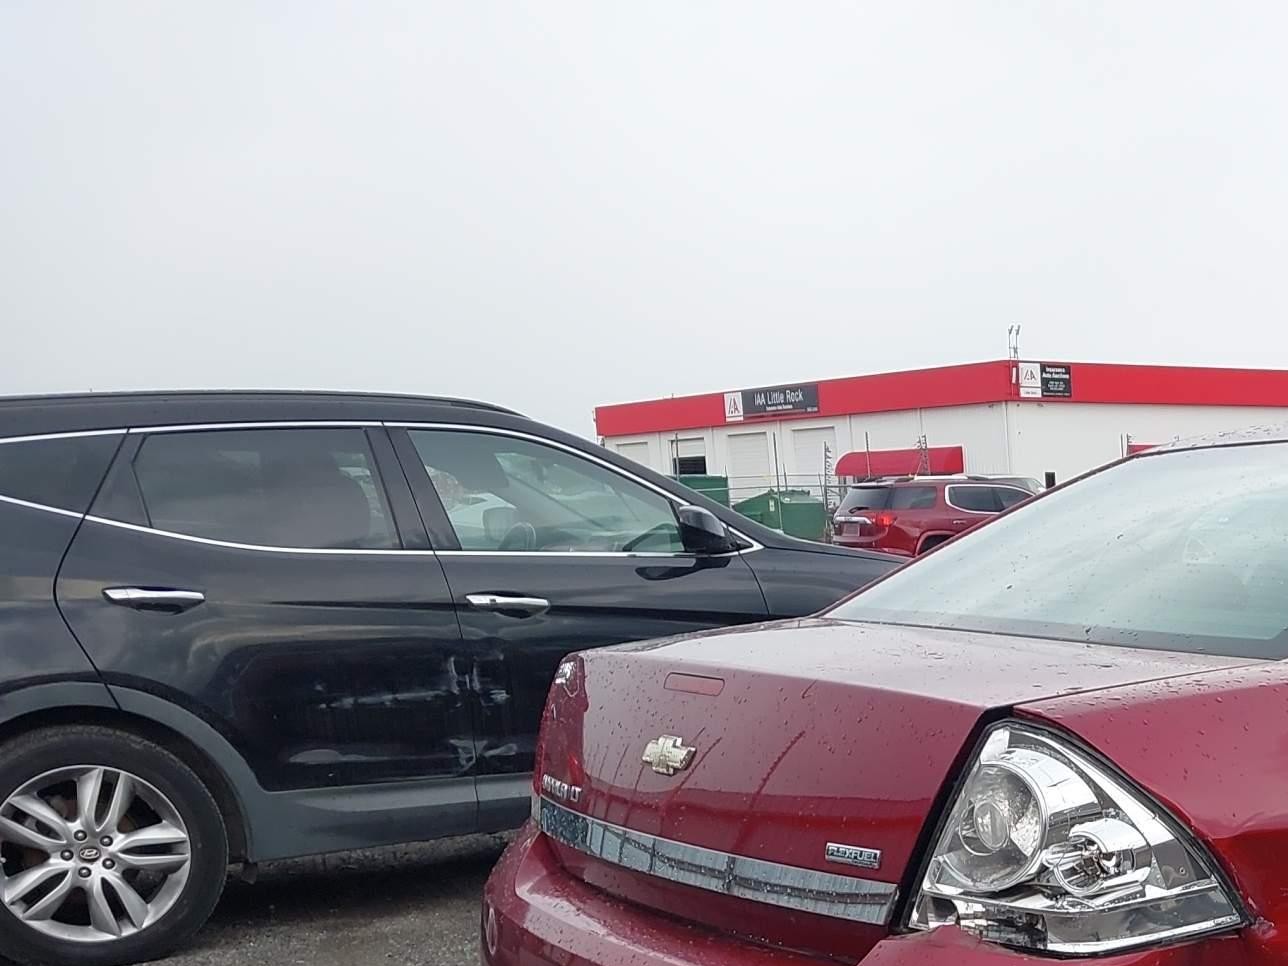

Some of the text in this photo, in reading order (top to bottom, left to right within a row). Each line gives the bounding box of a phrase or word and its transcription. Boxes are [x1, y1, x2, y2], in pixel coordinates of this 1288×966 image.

[754, 388, 804, 406] IAA Little Rock
[828, 846, 876, 862] FLEXFUEL
